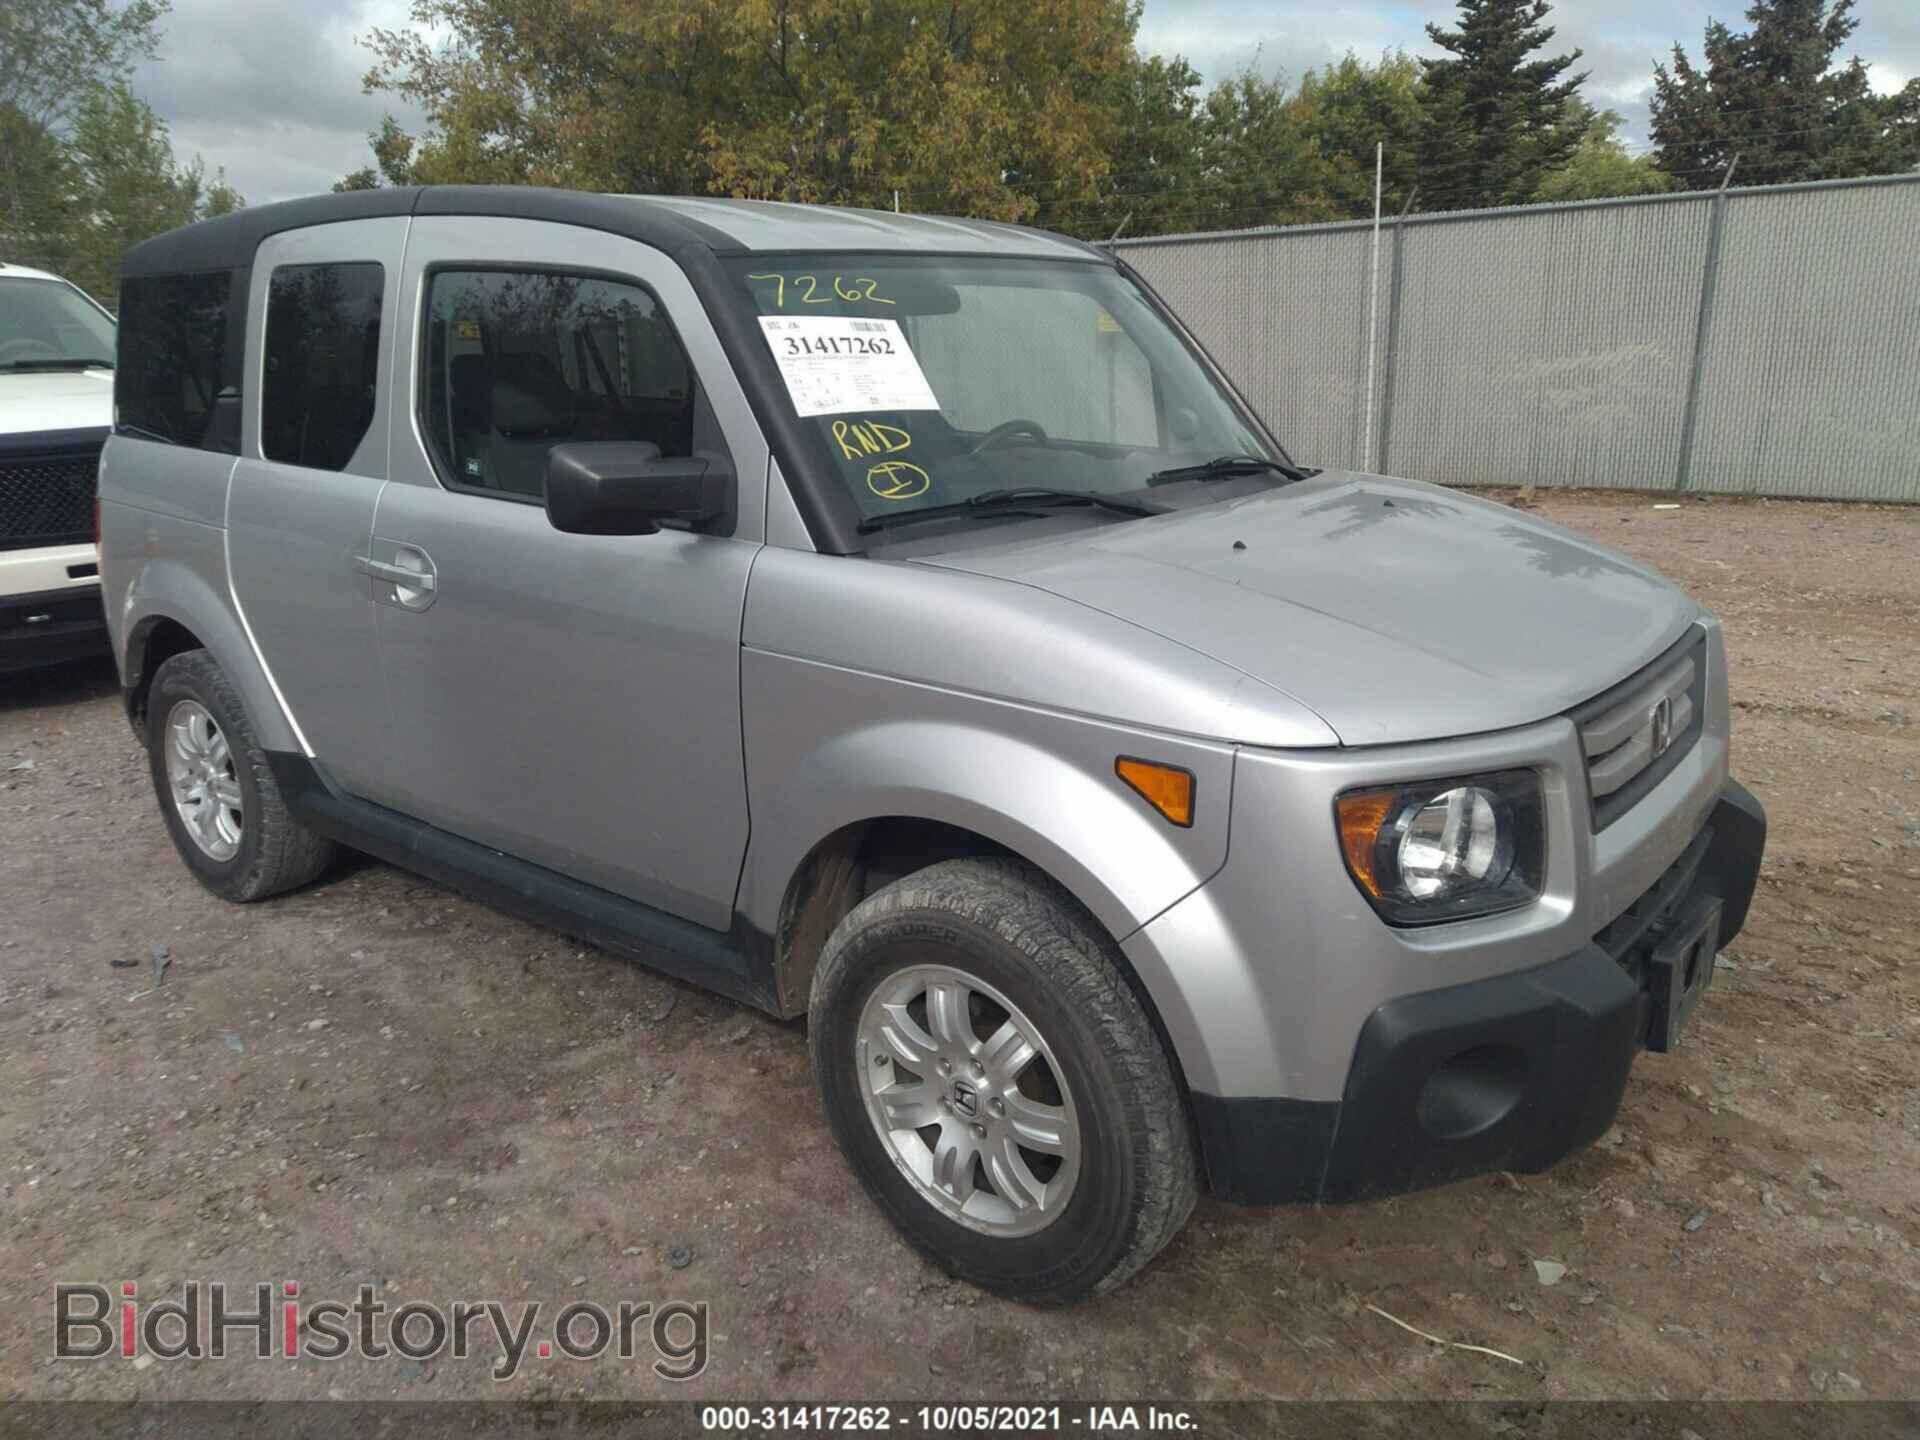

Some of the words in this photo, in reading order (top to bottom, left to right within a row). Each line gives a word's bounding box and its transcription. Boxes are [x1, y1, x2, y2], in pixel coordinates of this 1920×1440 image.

[748, 274, 896, 308] 7262
[783, 336, 896, 356] 31417262
[831, 419, 912, 461] RND
